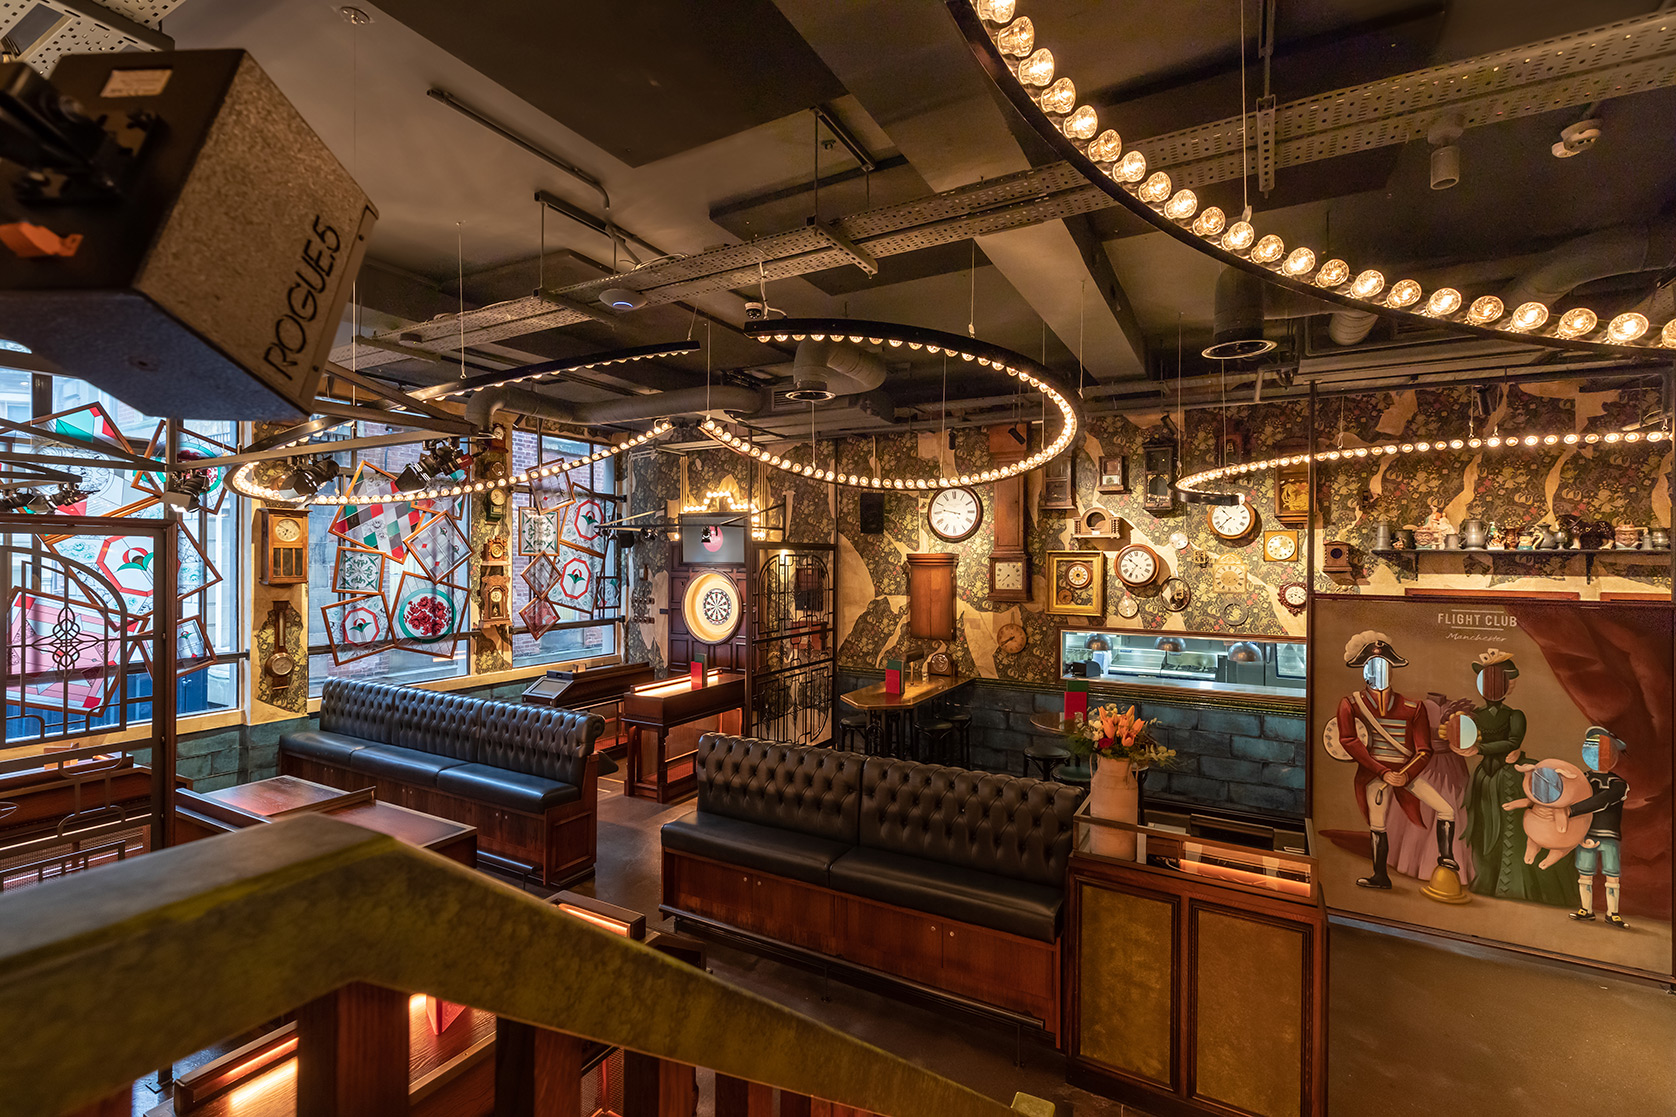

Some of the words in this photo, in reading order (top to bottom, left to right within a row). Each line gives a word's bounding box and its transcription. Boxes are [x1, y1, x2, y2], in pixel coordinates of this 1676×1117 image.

[1438, 613, 1481, 626] FLIGHT
[1485, 615, 1518, 627] CLUB
[1446, 632, 1507, 642] Manchester
